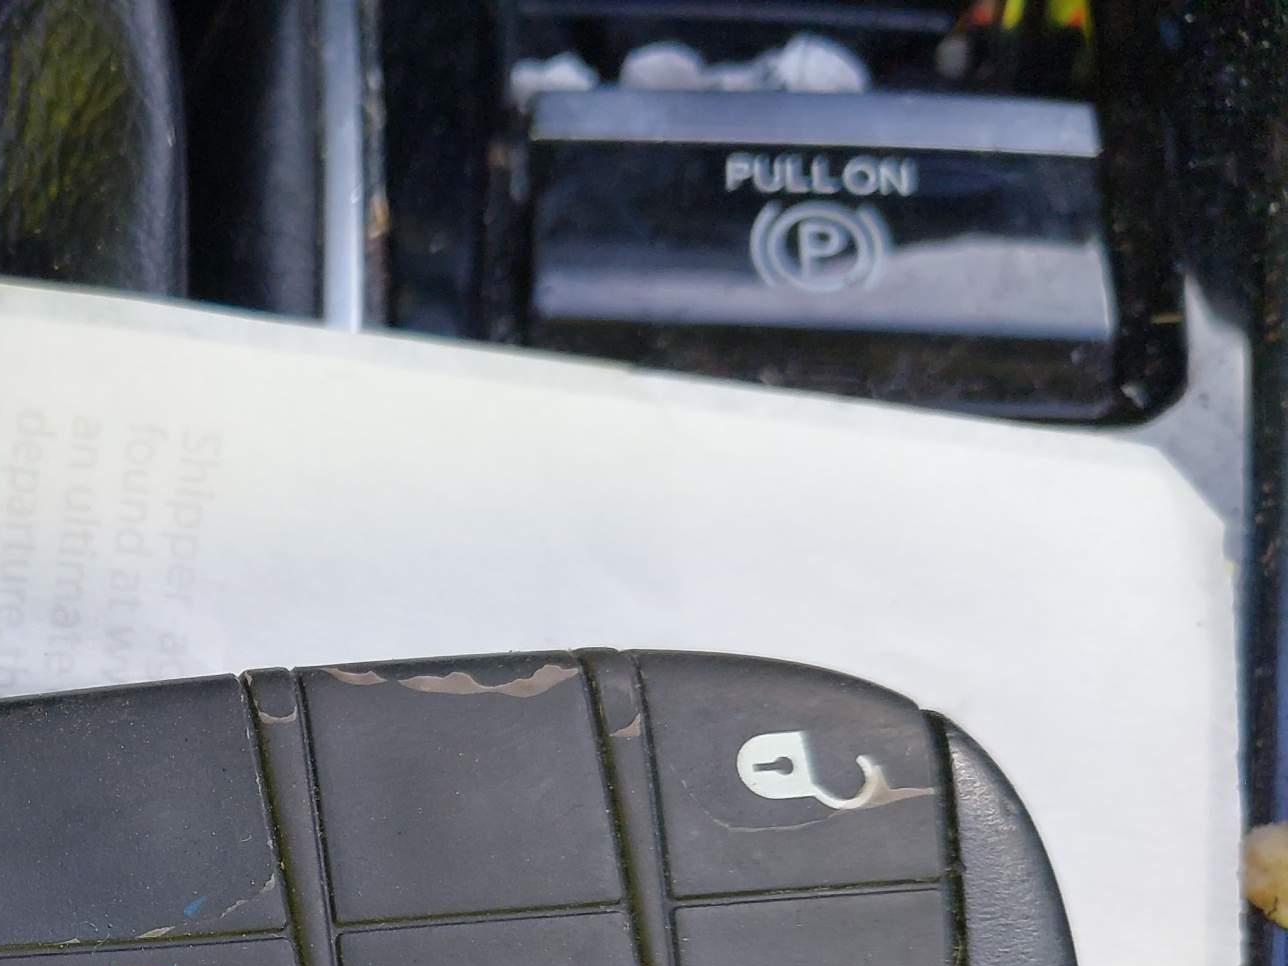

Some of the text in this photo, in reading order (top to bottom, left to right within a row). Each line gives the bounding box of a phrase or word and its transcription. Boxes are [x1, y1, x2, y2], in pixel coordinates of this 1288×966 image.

[725, 152, 840, 194] PULL
[68, 415, 103, 470] an
[113, 422, 169, 558] found
[107, 567, 144, 613] at
